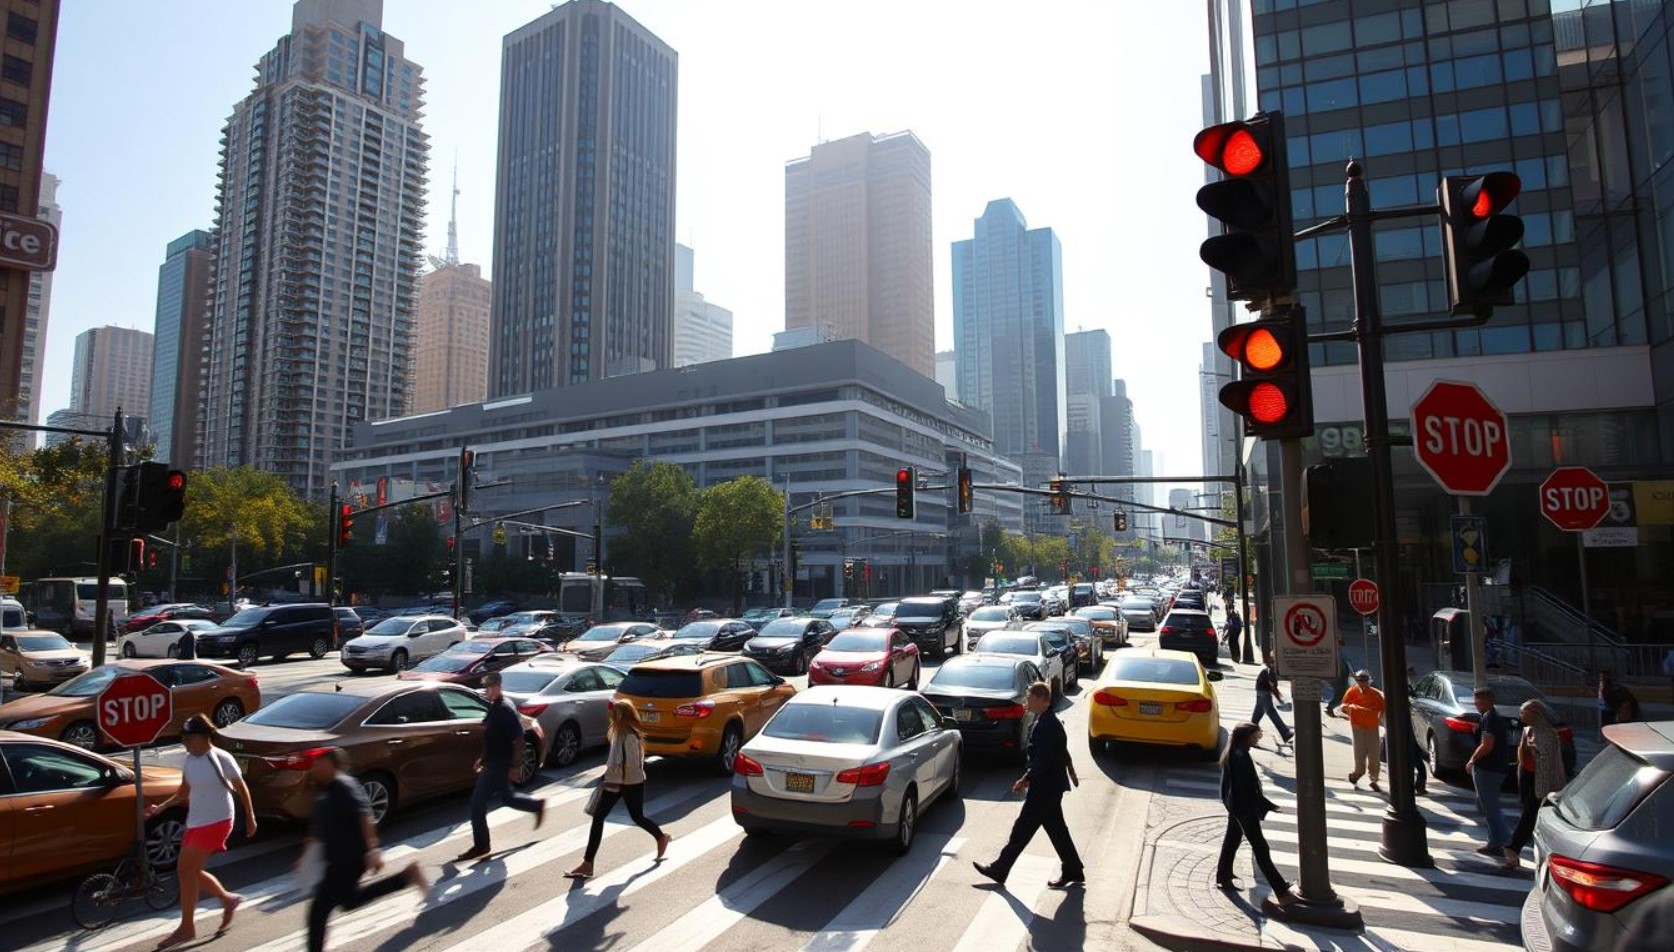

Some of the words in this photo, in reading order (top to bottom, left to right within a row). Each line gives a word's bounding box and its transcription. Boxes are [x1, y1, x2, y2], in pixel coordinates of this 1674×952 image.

[1425, 415, 1500, 458] STOP
[1546, 487, 1604, 511] STOP
[104, 693, 165, 727] STOP
